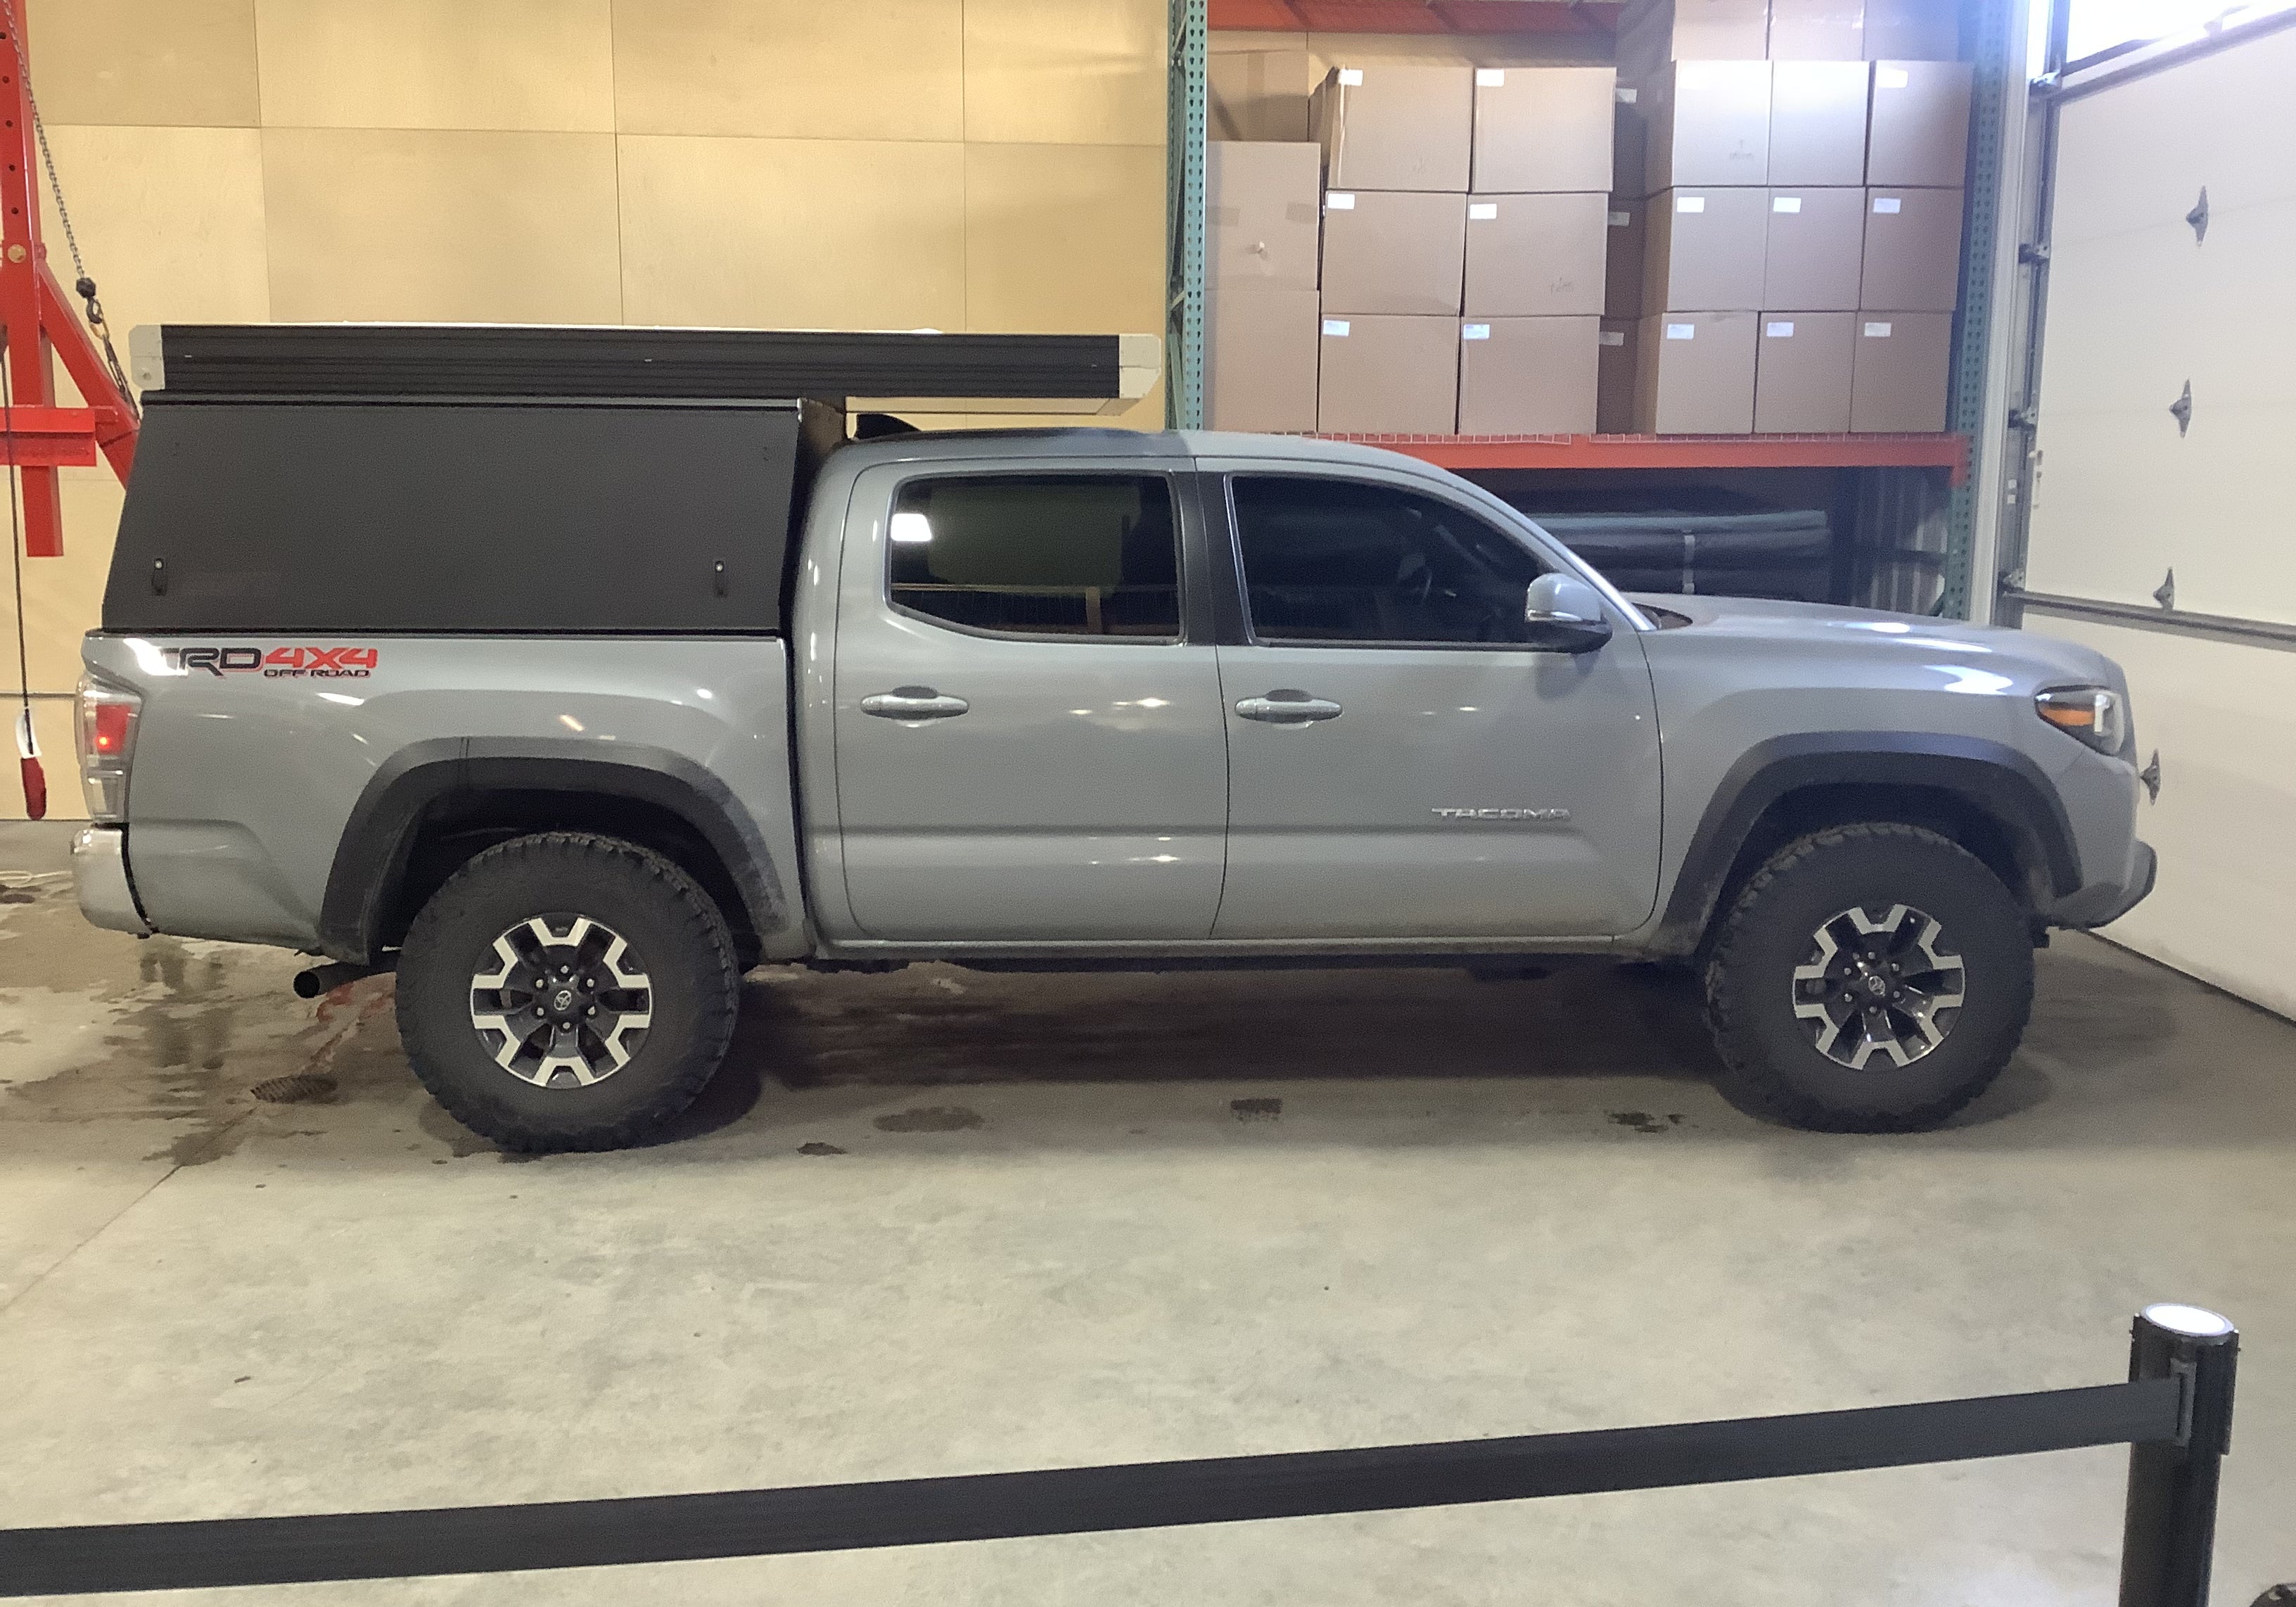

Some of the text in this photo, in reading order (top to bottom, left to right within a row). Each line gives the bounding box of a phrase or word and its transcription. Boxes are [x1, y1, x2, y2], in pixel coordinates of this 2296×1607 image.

[265, 647, 378, 668] 4X4
[264, 669, 370, 678] OFF ROAD
[1431, 808, 1571, 820] TACOMA
